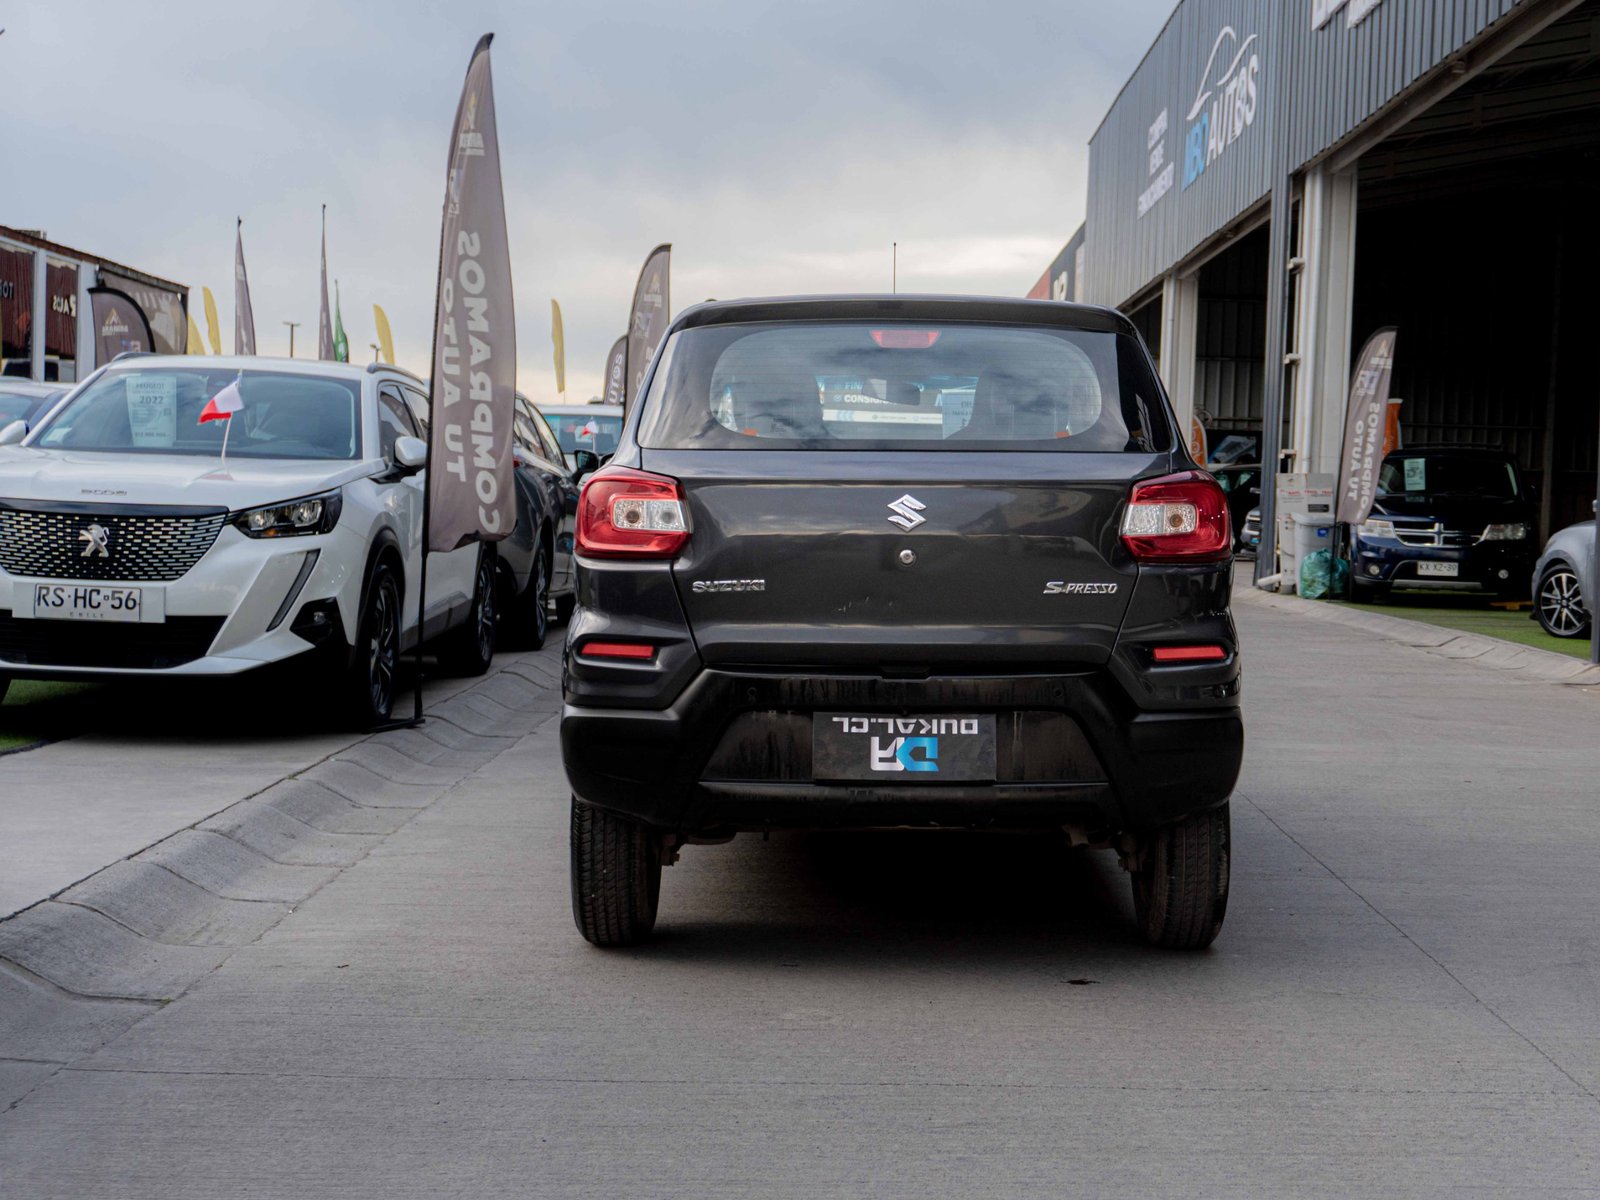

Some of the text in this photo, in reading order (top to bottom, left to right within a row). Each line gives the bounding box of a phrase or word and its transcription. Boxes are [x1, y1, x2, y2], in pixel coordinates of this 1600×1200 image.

[609, 353, 623, 403] UTOS
[139, 395, 164, 404] 2022
[692, 580, 765, 593] SUZUKI
[1043, 581, 1118, 594] S-PRESSO
[832, 717, 979, 735] DUKAL.CL
